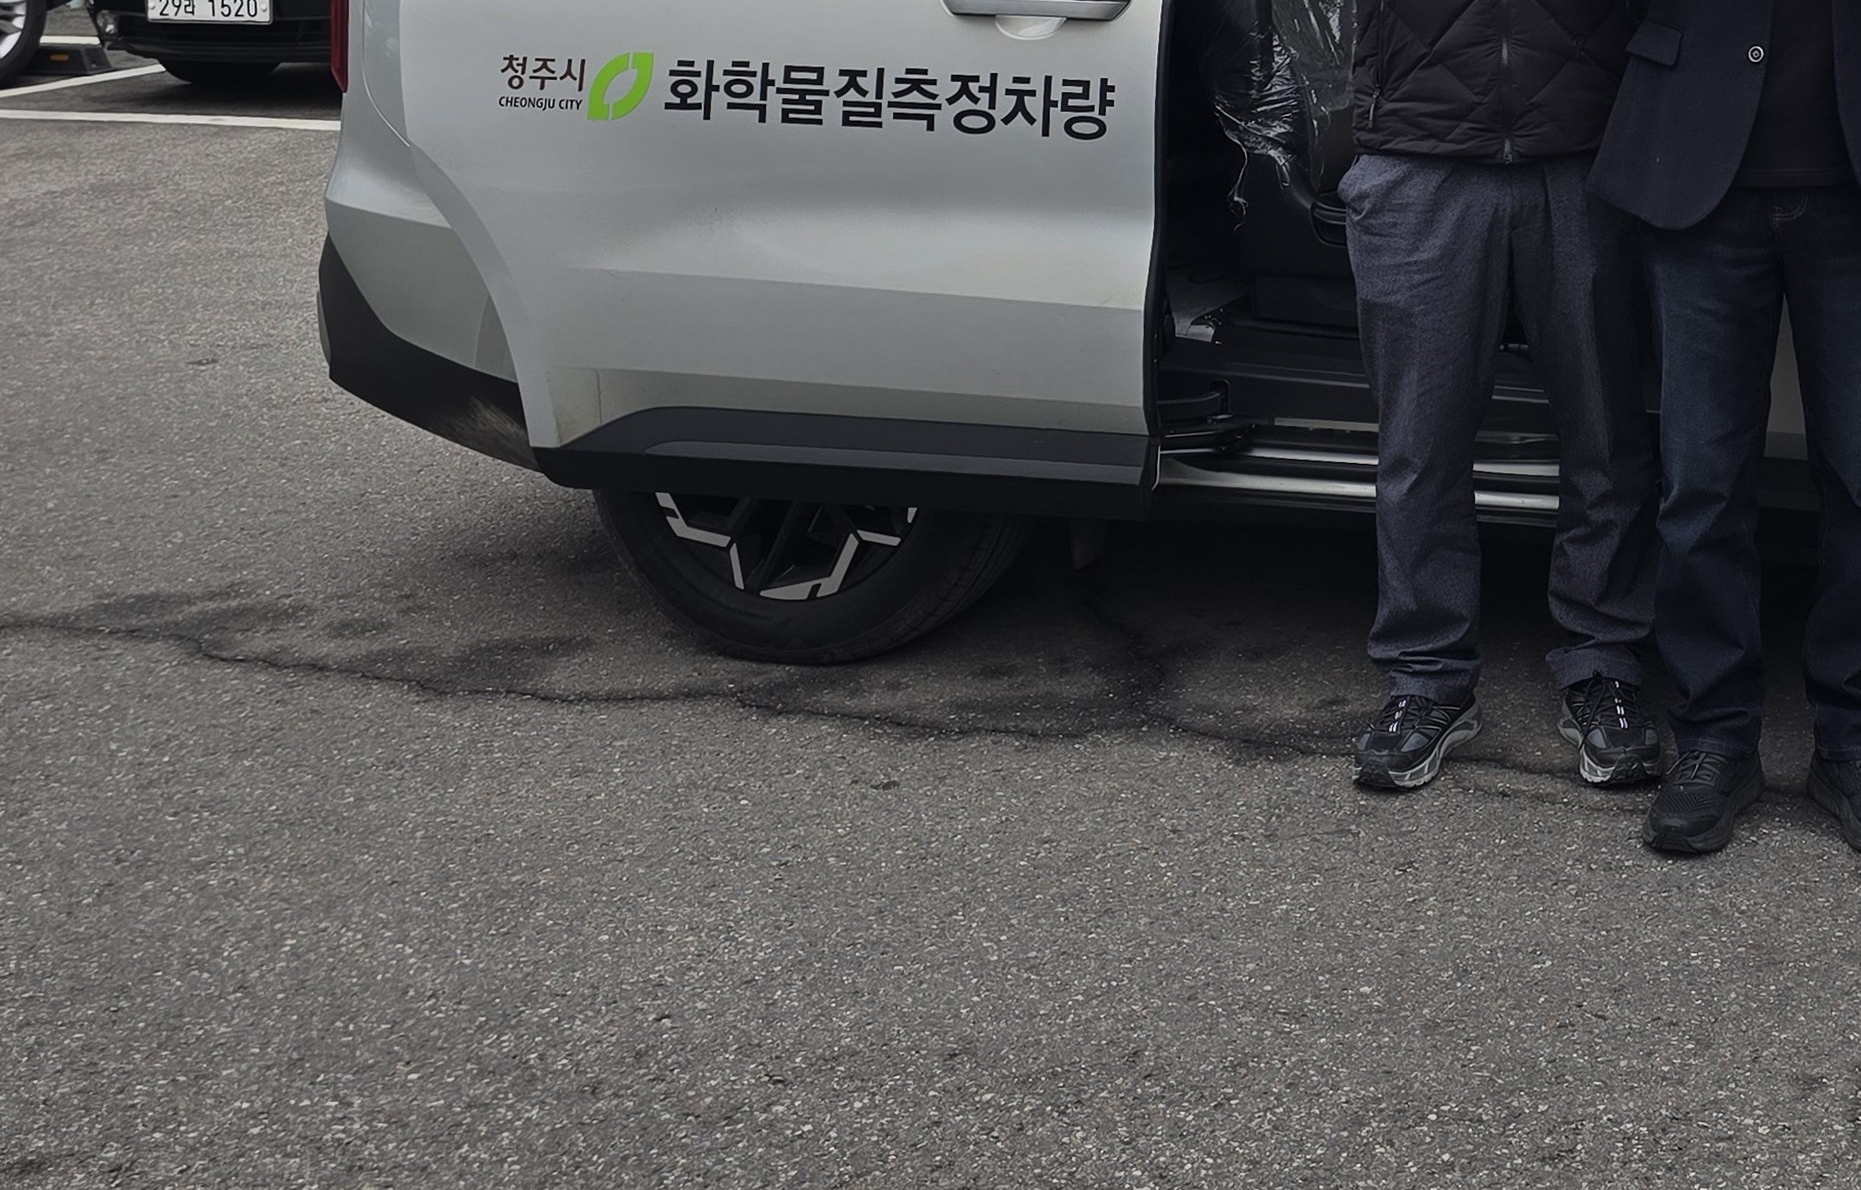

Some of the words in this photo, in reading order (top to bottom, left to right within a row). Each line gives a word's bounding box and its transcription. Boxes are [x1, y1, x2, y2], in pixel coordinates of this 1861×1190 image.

[500, 54, 586, 92] 청주시
[498, 96, 556, 111] CHEONGJU
[558, 99, 583, 111] CITY
[663, 59, 1116, 141] 화학물질측정차량
